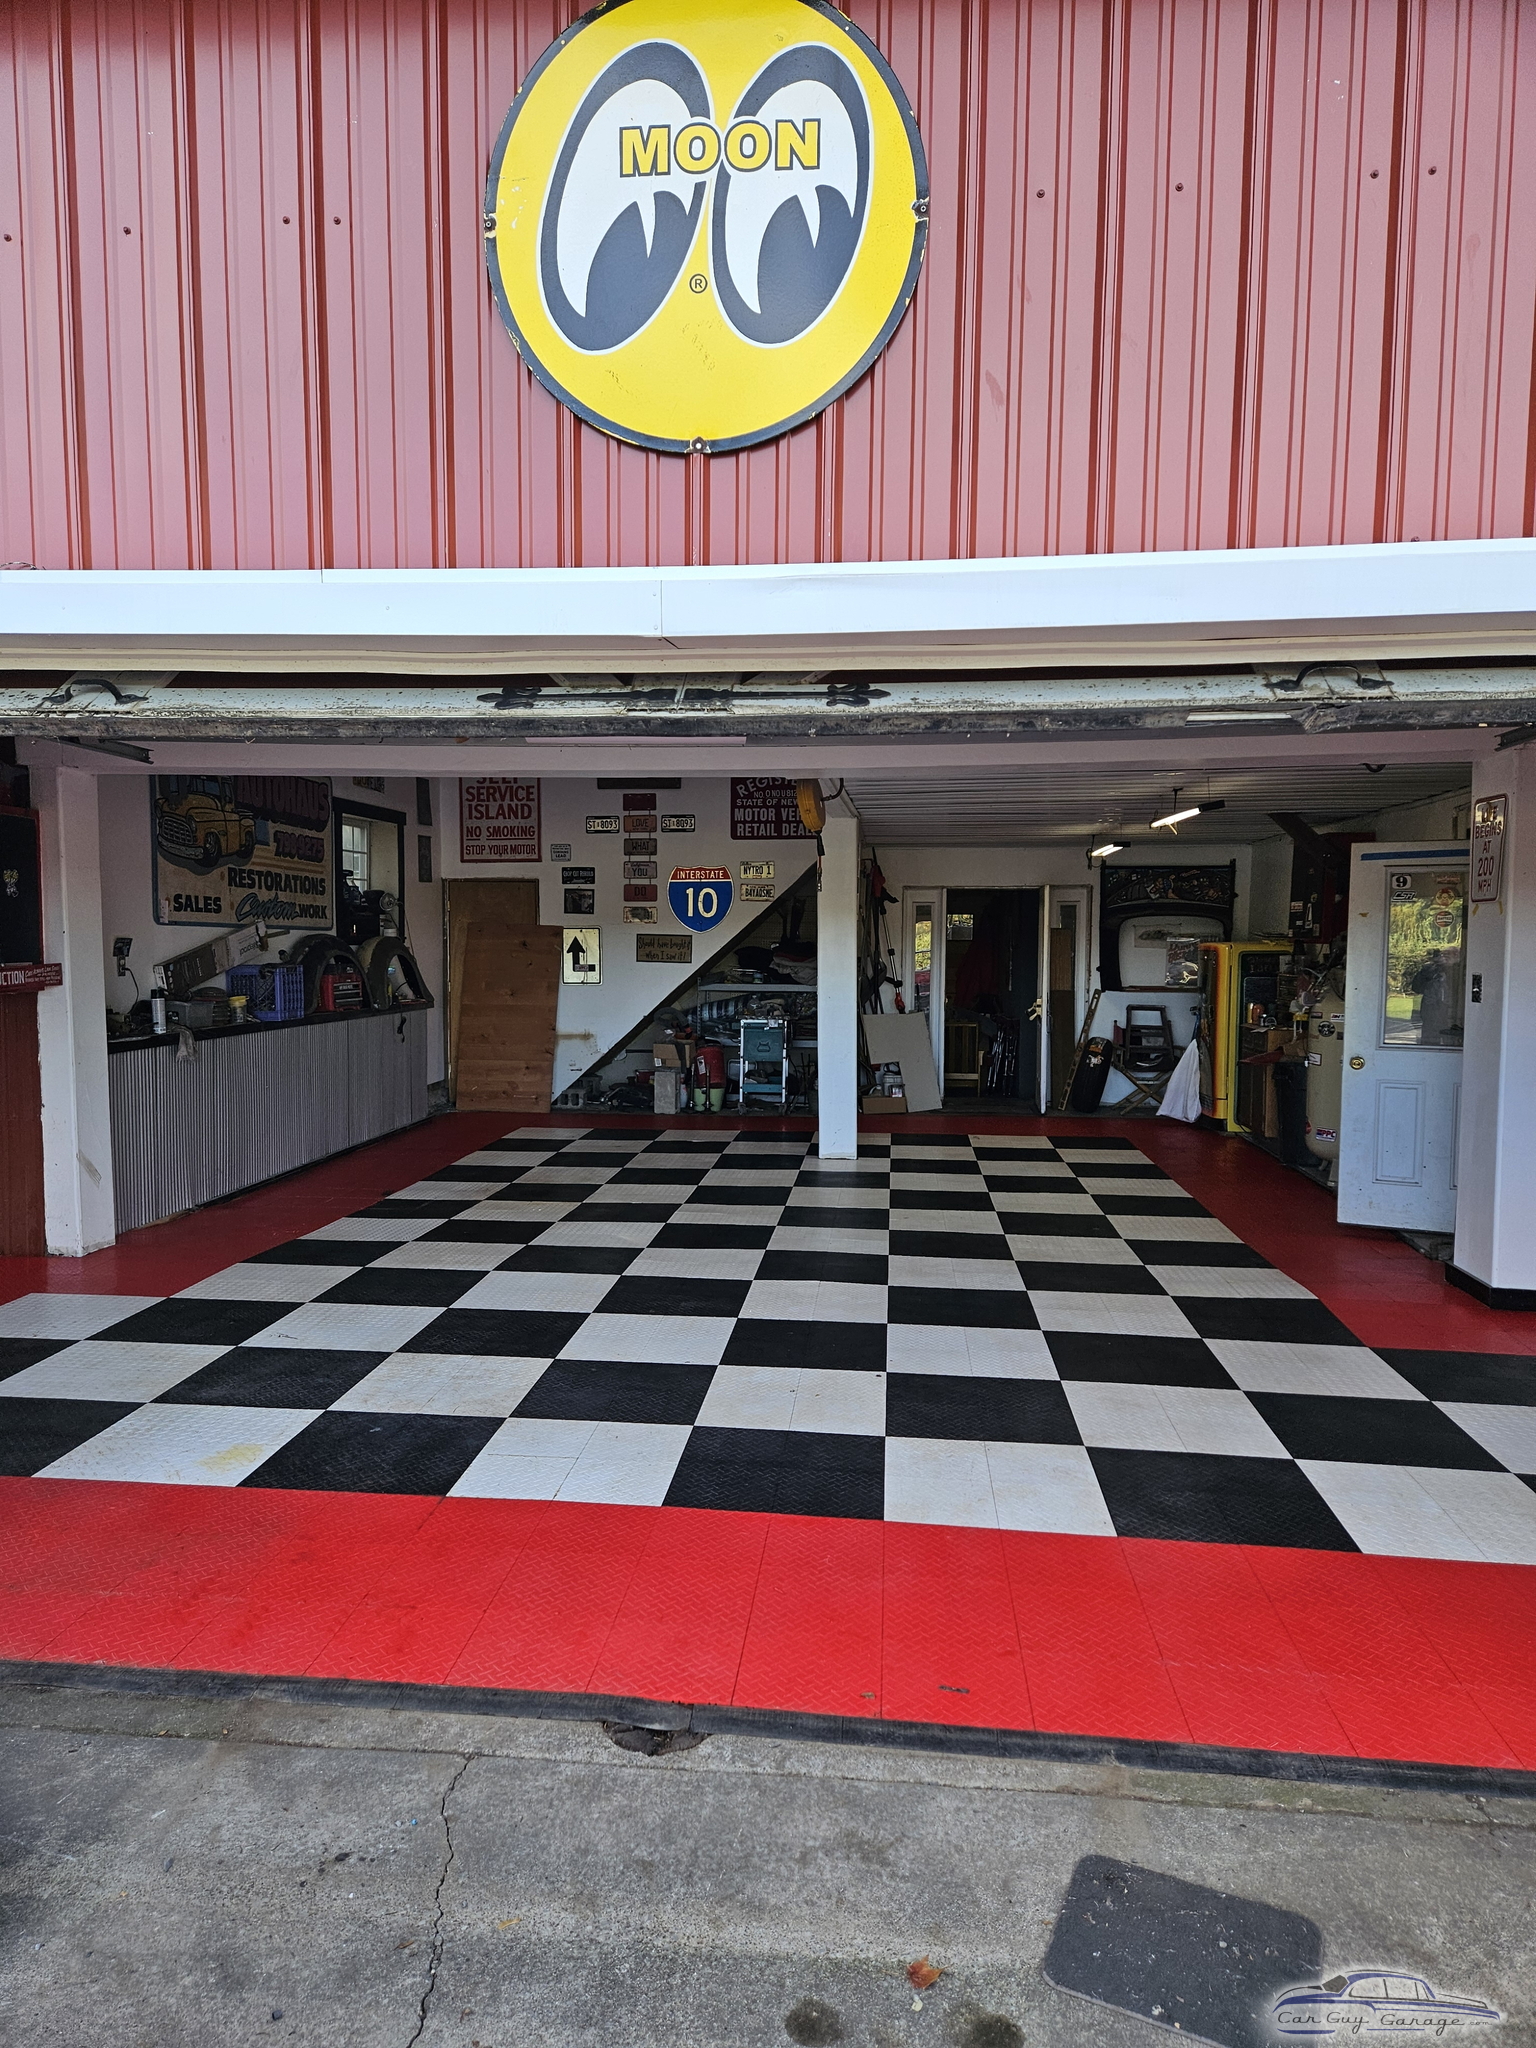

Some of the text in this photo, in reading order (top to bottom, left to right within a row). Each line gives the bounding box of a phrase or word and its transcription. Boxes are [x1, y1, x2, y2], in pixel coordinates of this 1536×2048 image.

[619, 118, 821, 178] MOON
[465, 785, 535, 802] SERVICE
[235, 776, 330, 828] AUTOHAUS
[736, 798, 763, 806] STATE
[766, 798, 778, 806] OF
[468, 803, 532, 820] ISLAND
[734, 807, 776, 821] MOTOR
[631, 818, 649, 827] LOVE
[736, 823, 778, 836] RETAIL
[466, 825, 536, 838] NO SMOKING
[1475, 821, 1502, 839] BEGINS
[465, 844, 537, 856] STOP YOUR MOTOR
[631, 841, 650, 851] WHAT
[1482, 840, 1492, 854] AT
[631, 867, 648, 877] YOU
[1477, 856, 1495, 877] 200
[227, 866, 326, 896] RESTORATIONS
[677, 870, 724, 879] INTERSTATE
[1395, 875, 1408, 888] 9
[634, 886, 647, 896] DO
[1477, 879, 1492, 893] MPH
[173, 894, 222, 914] SALES
[235, 892, 328, 922] Custom WORK
[685, 887, 718, 918] 10
[0, 970, 25, 985] CTION
